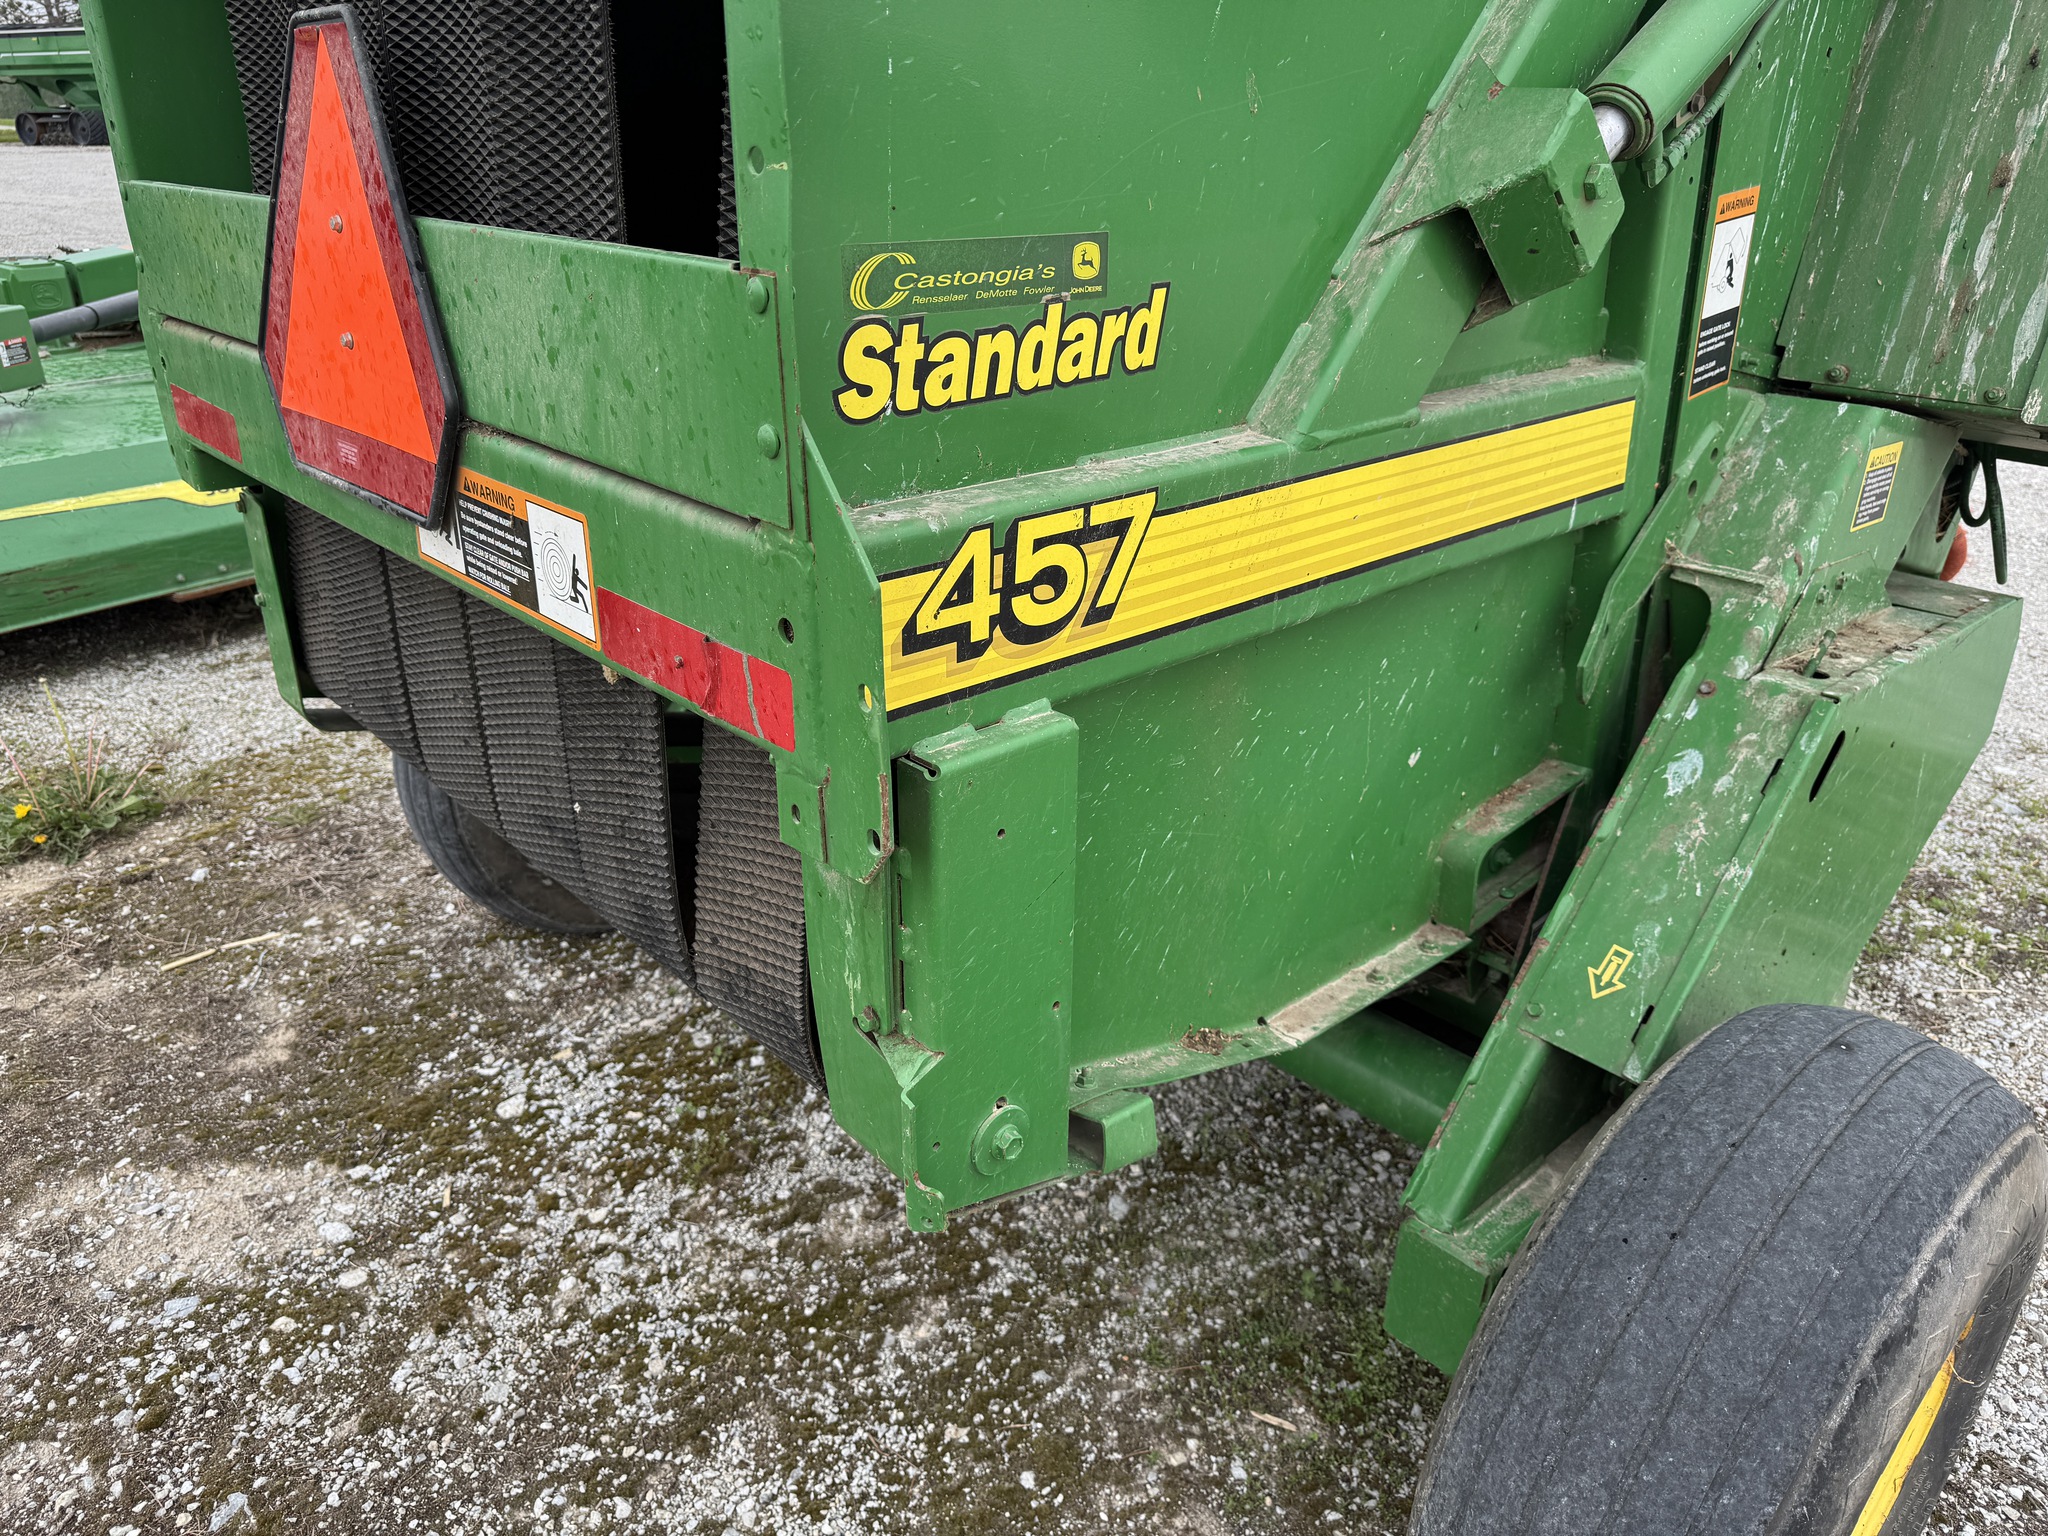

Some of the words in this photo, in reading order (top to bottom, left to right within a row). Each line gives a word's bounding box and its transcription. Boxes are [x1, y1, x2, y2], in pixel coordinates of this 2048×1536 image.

[1726, 196, 1755, 212] WARNING
[894, 264, 1056, 291] Castongia's
[912, 293, 968, 304] Rensselaer
[975, 289, 1017, 300] DeMotte
[1023, 285, 1055, 295] Fowler
[1070, 286, 1084, 295] JOHN
[1085, 285, 1103, 293] DEERE
[834, 284, 1169, 423] Standard
[1875, 451, 1897, 466] CAUTION
[470, 480, 515, 512] WARNING
[467, 502, 482, 515] PREVENT
[493, 526, 504, 537] stand
[504, 531, 514, 542] clear
[514, 535, 527, 548] before
[489, 553, 498, 564] GATE
[906, 488, 1158, 658] 457
